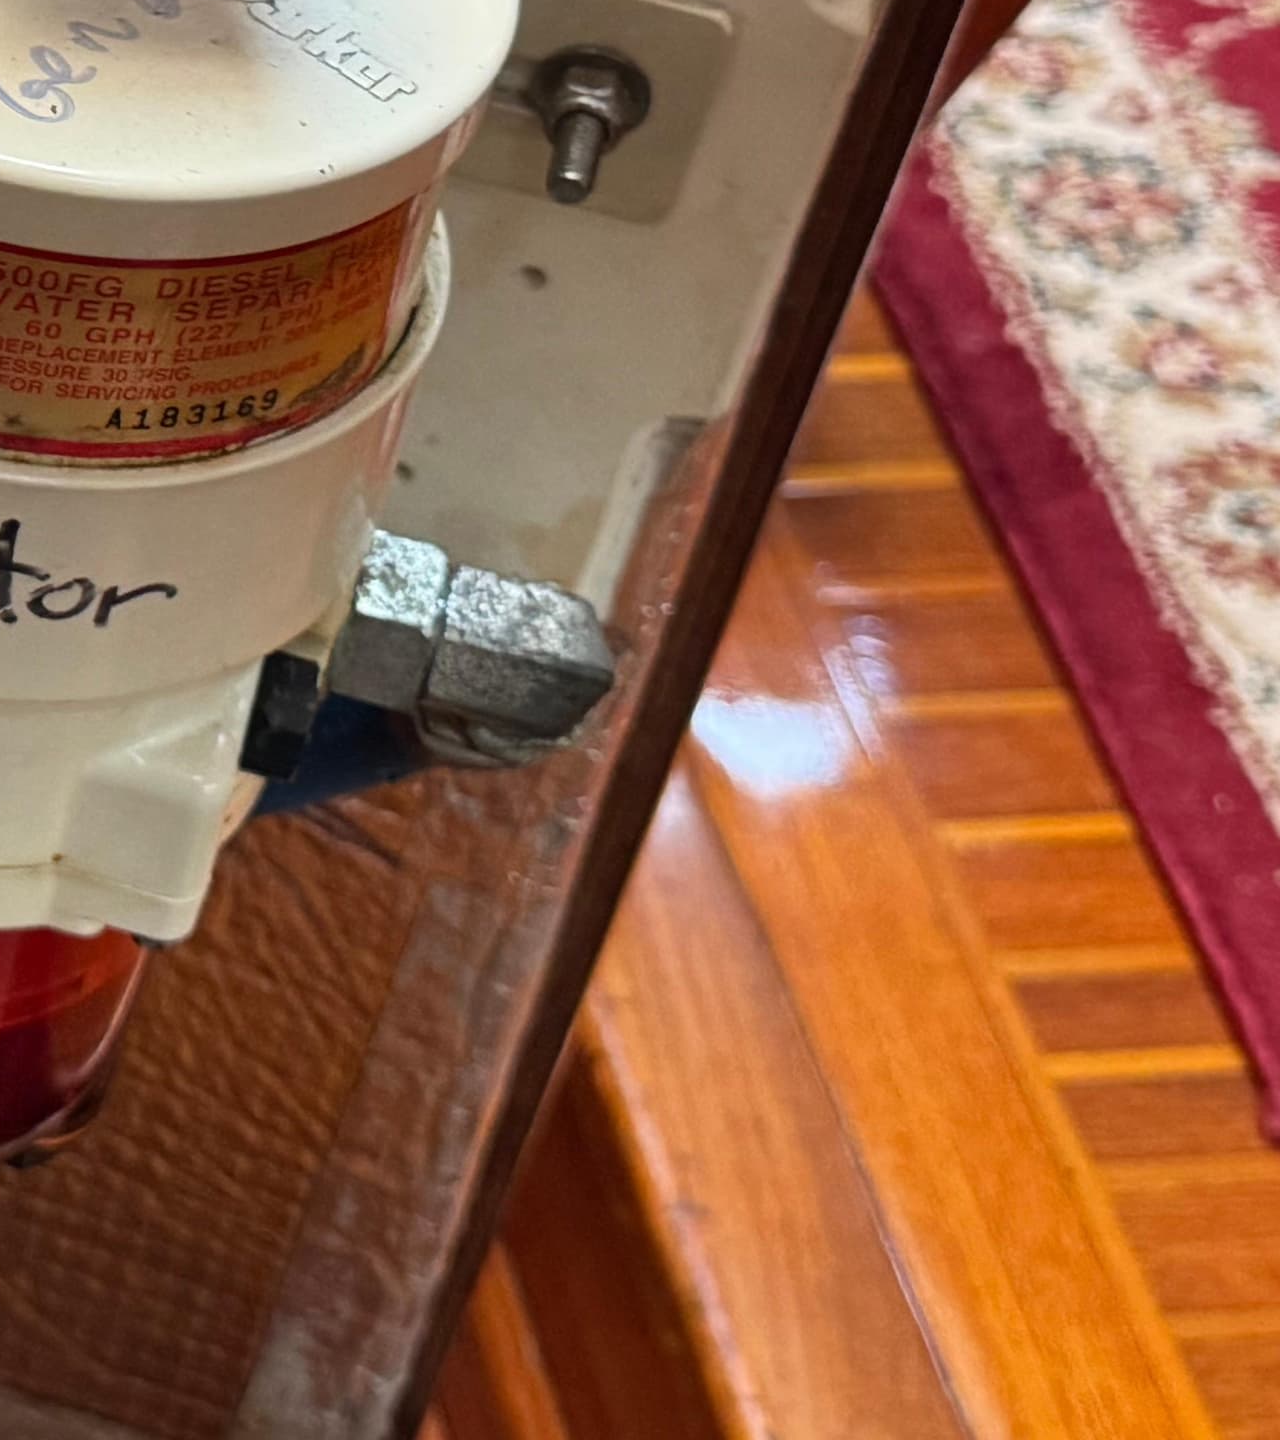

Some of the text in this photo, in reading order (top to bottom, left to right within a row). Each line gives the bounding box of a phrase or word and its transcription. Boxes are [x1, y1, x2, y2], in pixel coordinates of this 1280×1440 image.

[156, 262, 300, 300] DIESEL
[25, 319, 62, 340] 60
[84, 326, 155, 346] GPH
[173, 336, 275, 365] ELEMENT
[102, 368, 128, 384] 30
[56, 382, 177, 401] SERVICING
[105, 388, 280, 431] A183169
